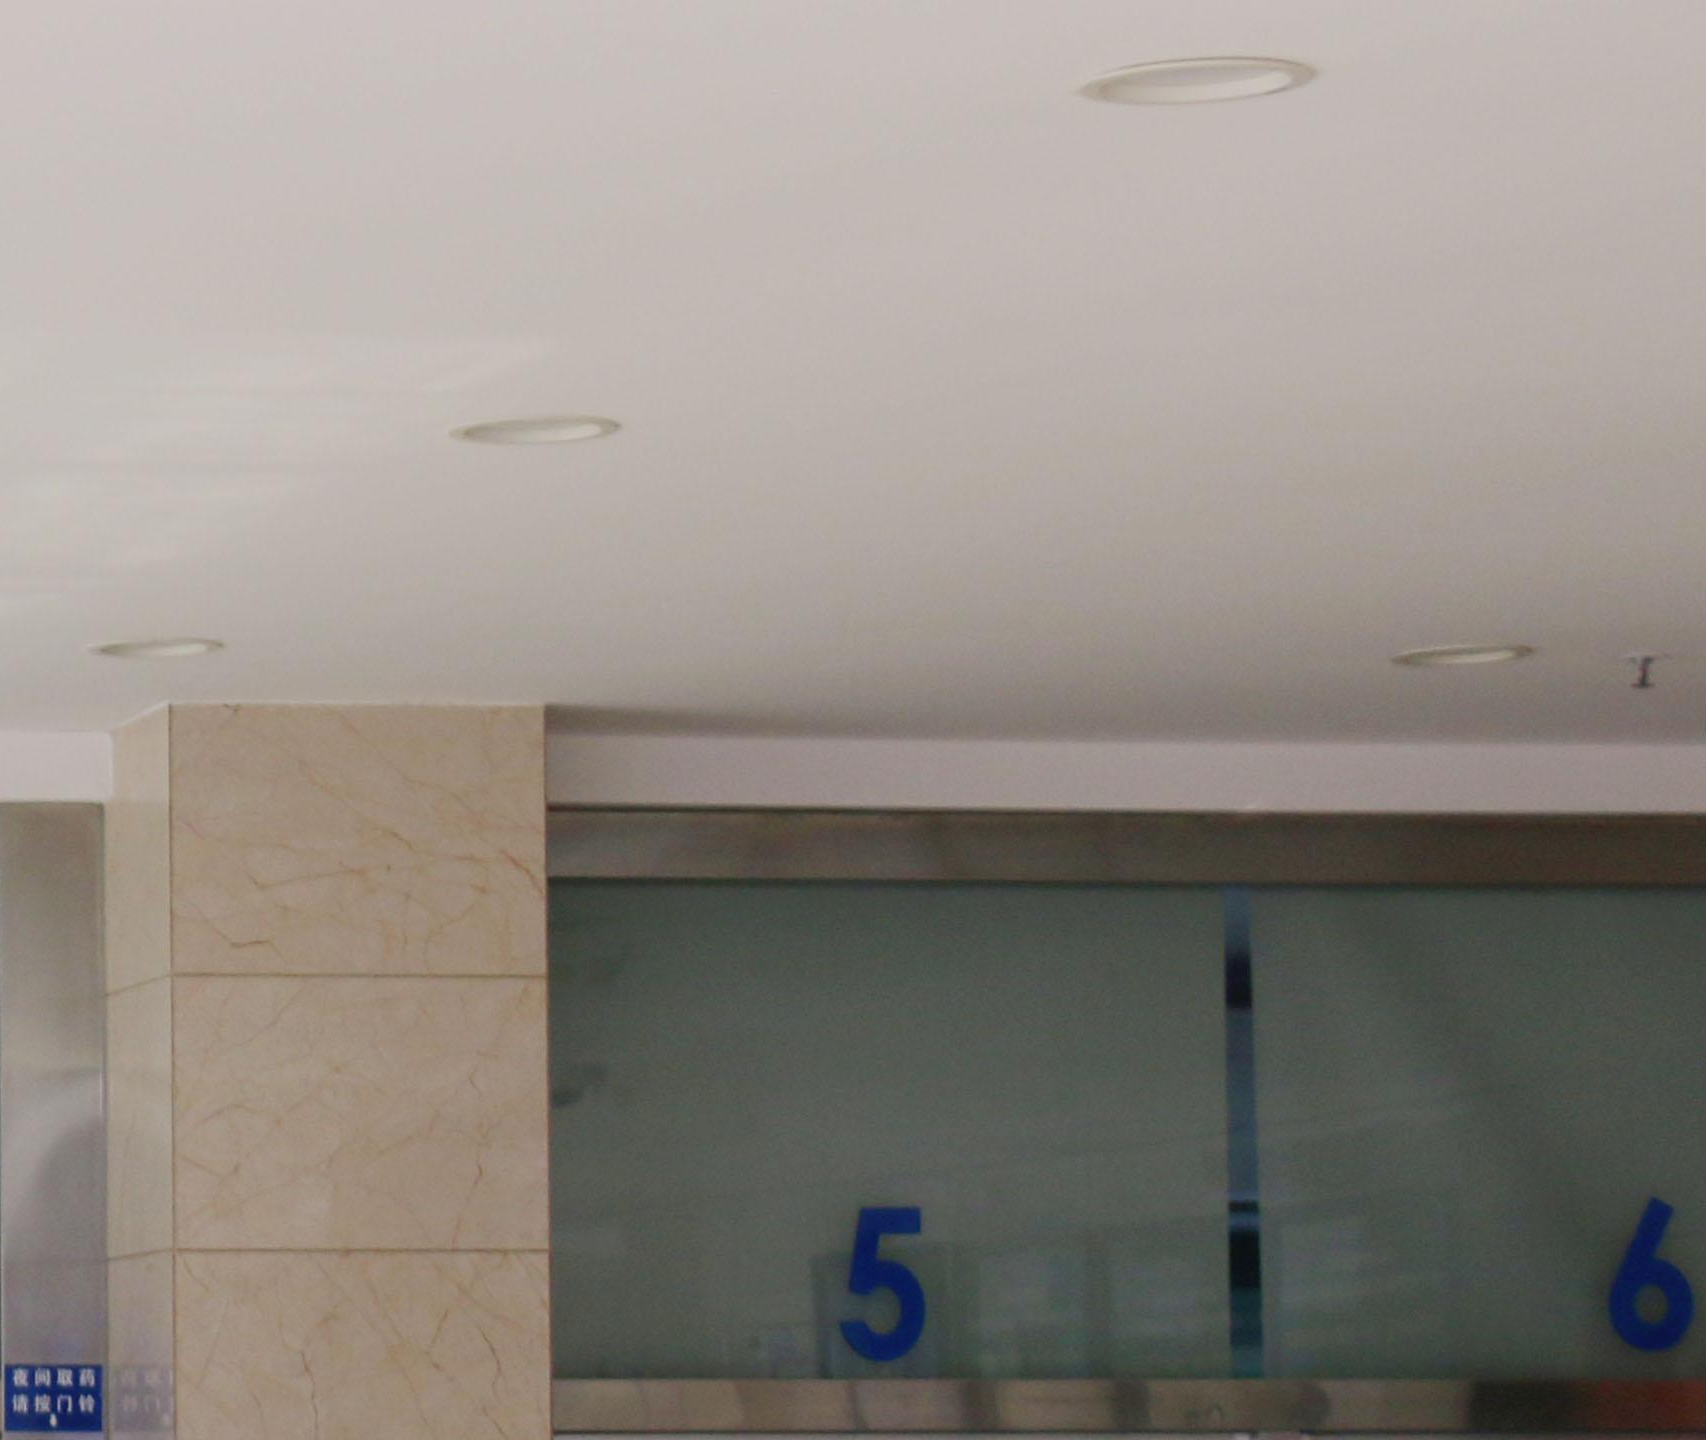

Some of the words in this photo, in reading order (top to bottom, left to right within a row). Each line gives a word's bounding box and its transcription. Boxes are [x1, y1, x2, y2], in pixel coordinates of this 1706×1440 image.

[840, 1207, 926, 1362] 5
[1608, 1198, 1695, 1353] 6
[12, 1367, 96, 1388] 夜间取药
[12, 1393, 96, 1415] 请按门铃
